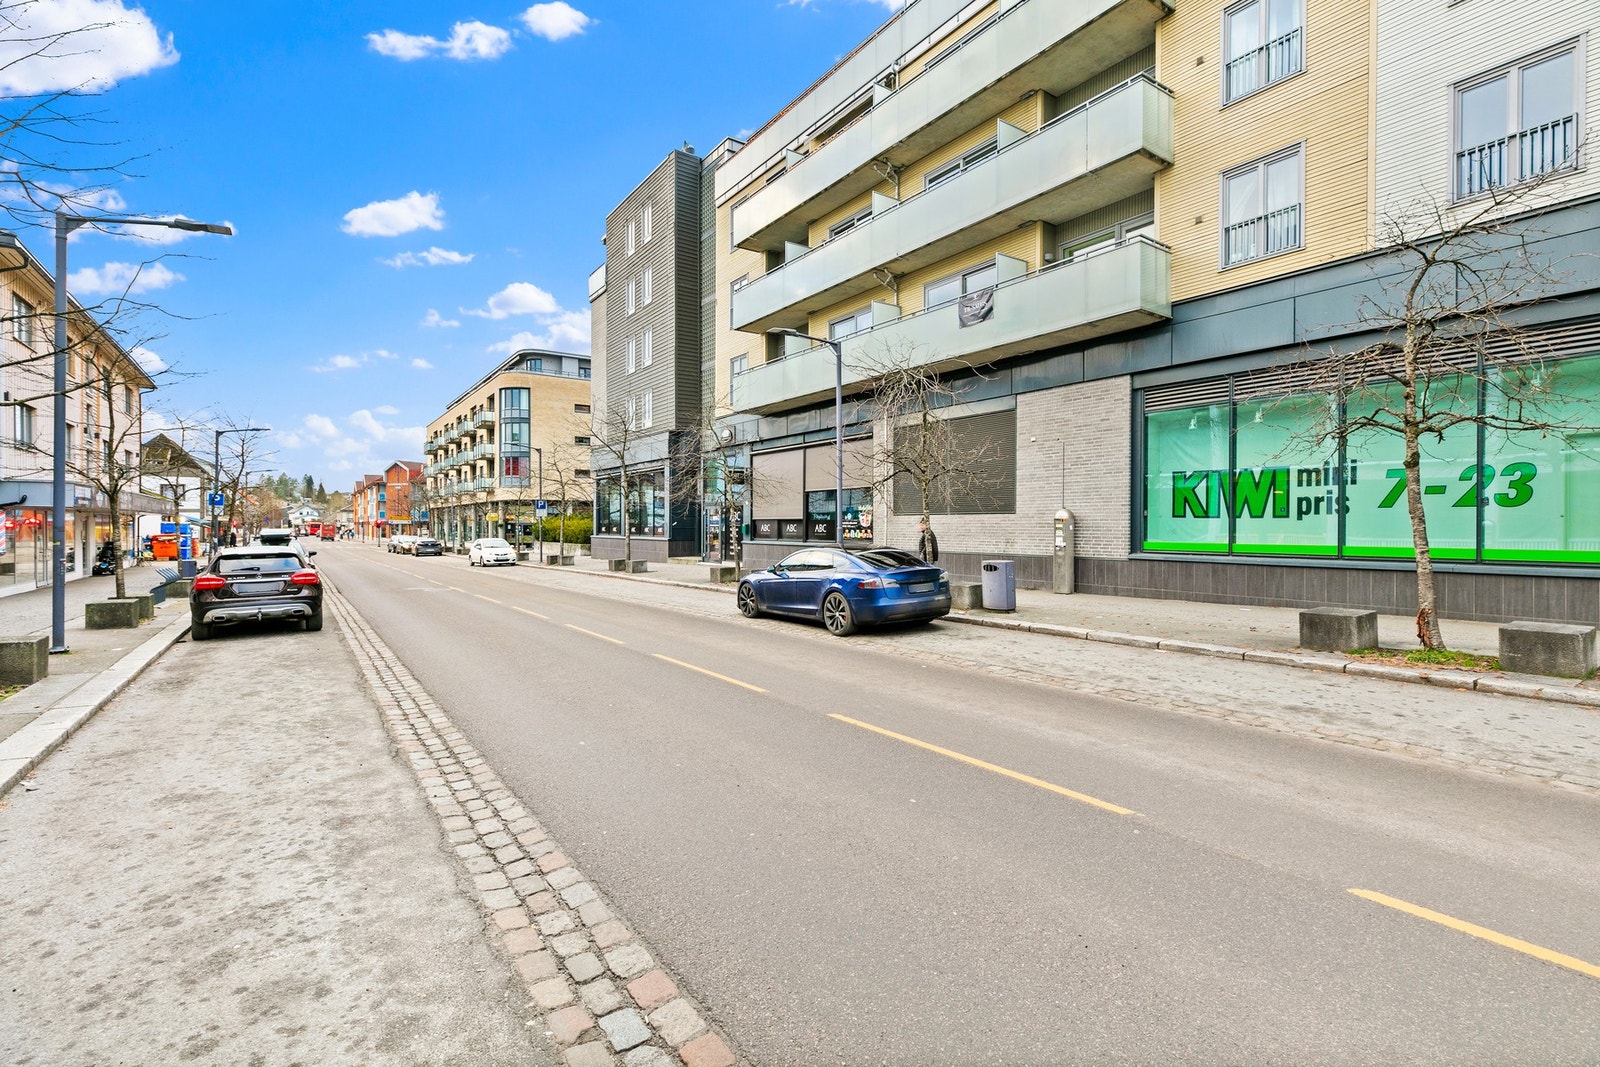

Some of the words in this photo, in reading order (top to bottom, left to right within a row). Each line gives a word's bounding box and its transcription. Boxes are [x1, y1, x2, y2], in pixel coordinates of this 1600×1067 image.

[1172, 466, 1290, 519] KIWI
[760, 524, 771, 532] ABC
[786, 524, 797, 533] ABC
[814, 523, 827, 533] ABC
